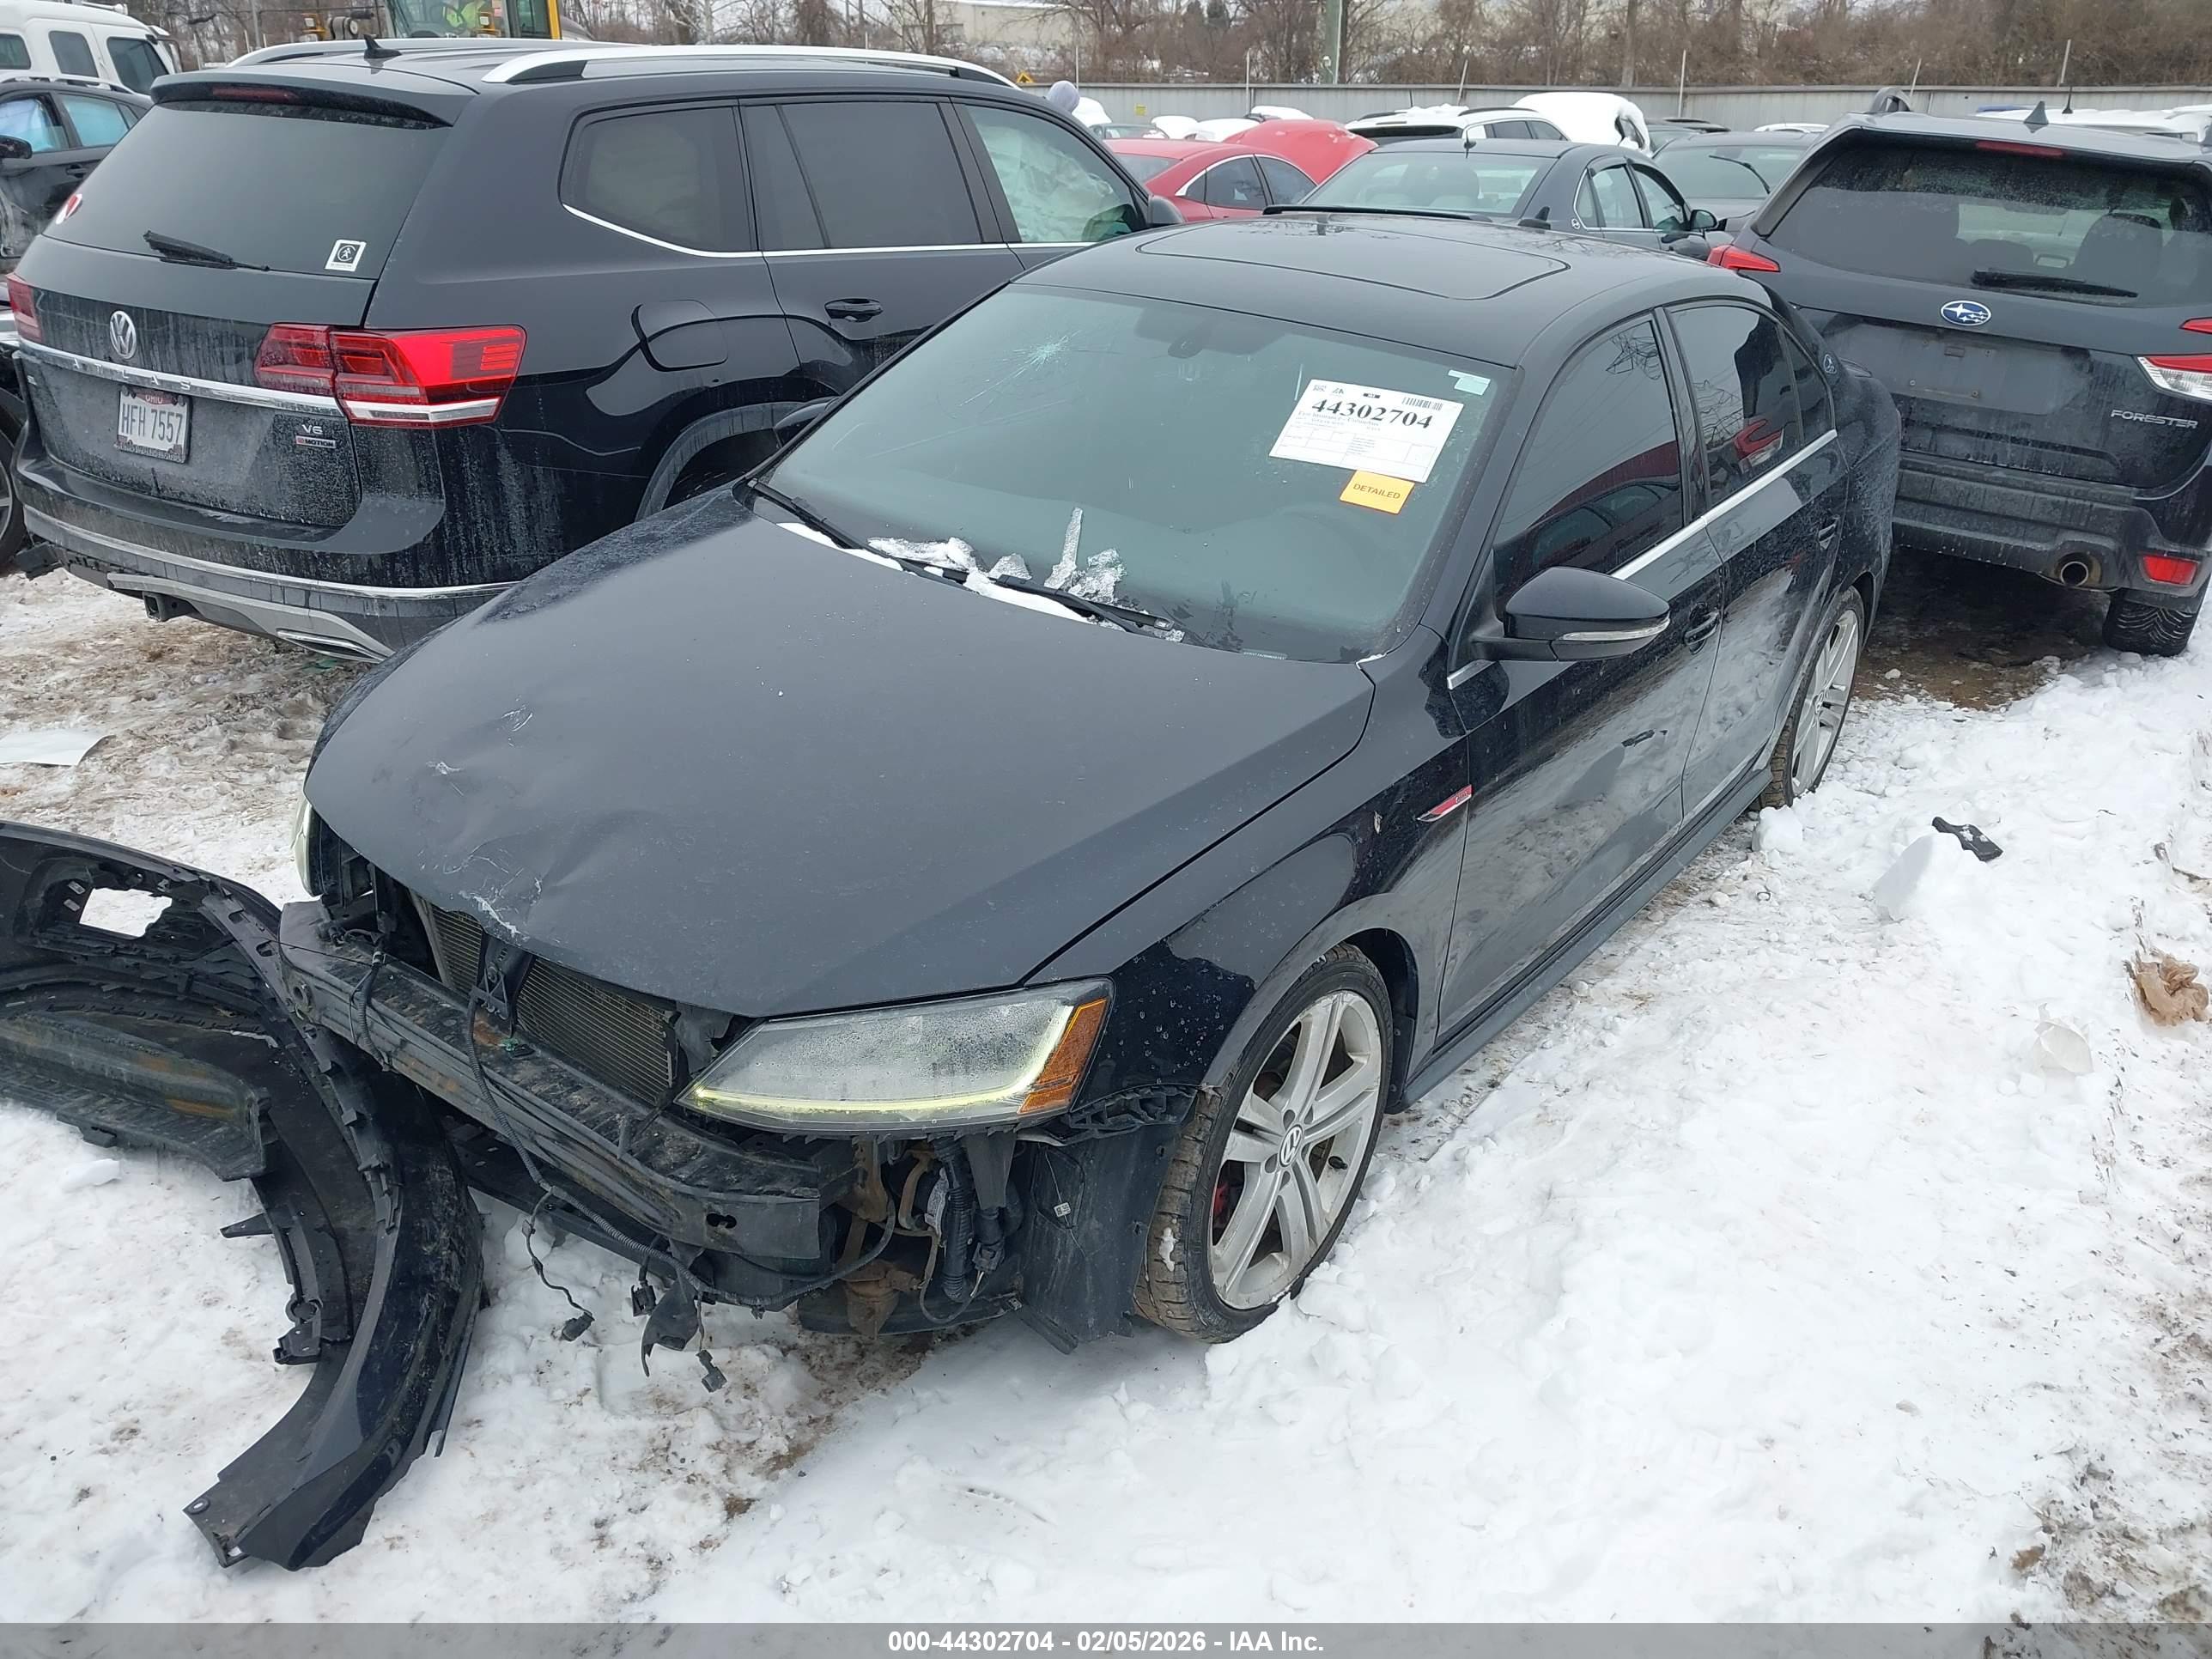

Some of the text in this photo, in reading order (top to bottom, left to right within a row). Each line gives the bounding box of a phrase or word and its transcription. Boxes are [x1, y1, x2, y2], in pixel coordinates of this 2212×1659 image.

[74, 358, 191, 391] ATLAS
[121, 403, 183, 445] HFH 7557
[1311, 398, 1433, 429] 44302704
[2110, 409, 2198, 429] FORESTER
[301, 423, 324, 435] V6
[1352, 483, 1401, 500] DETAILED
